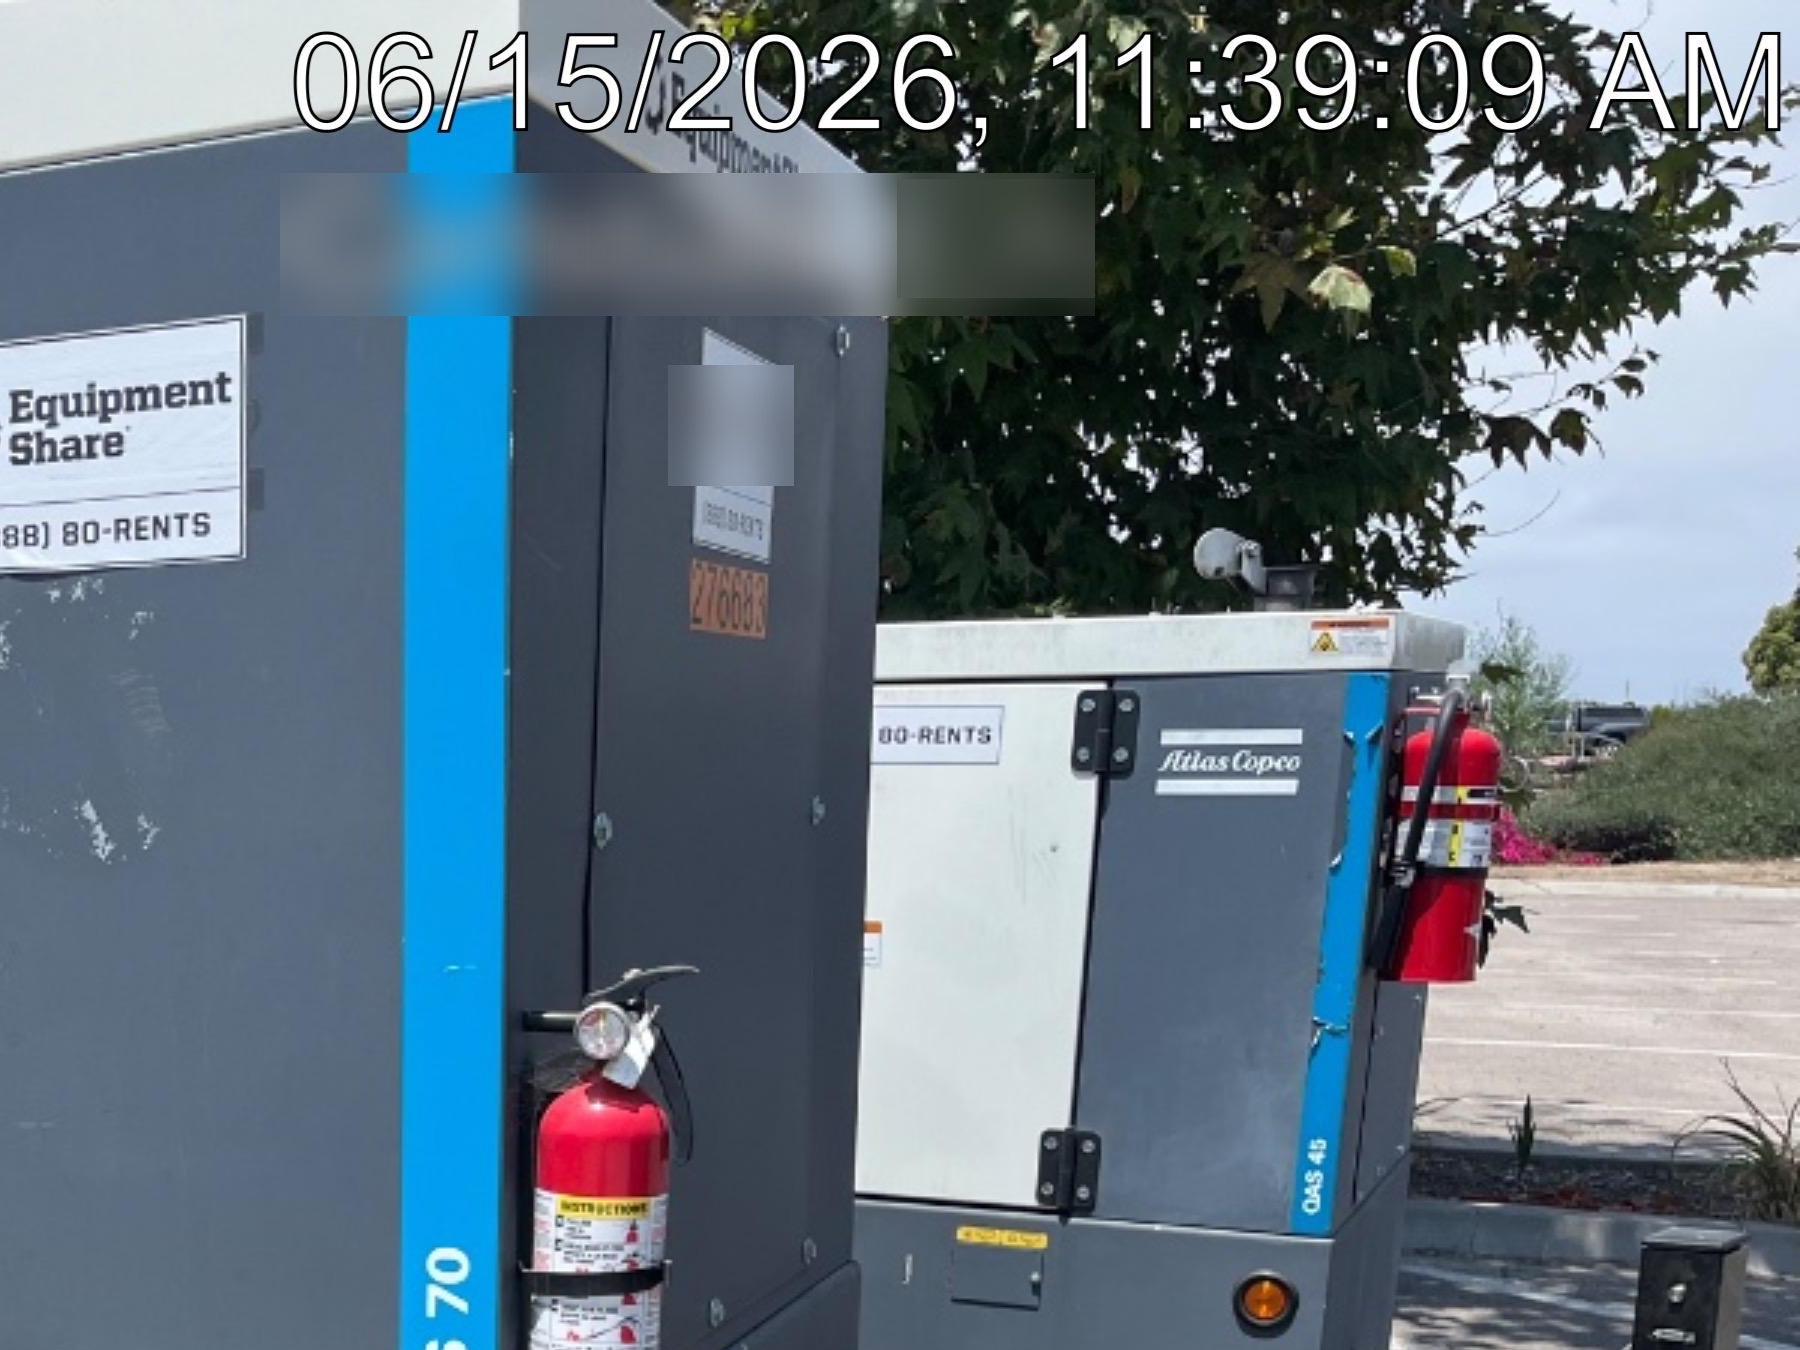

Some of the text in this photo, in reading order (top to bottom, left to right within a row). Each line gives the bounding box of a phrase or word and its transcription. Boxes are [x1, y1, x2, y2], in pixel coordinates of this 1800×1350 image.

[9, 371, 232, 428] Equipment
[9, 431, 125, 466] Share
[62, 512, 211, 547] 80-RENTS
[1157, 749, 1301, 775] Atlas Copco
[425, 1247, 471, 1318] 70
